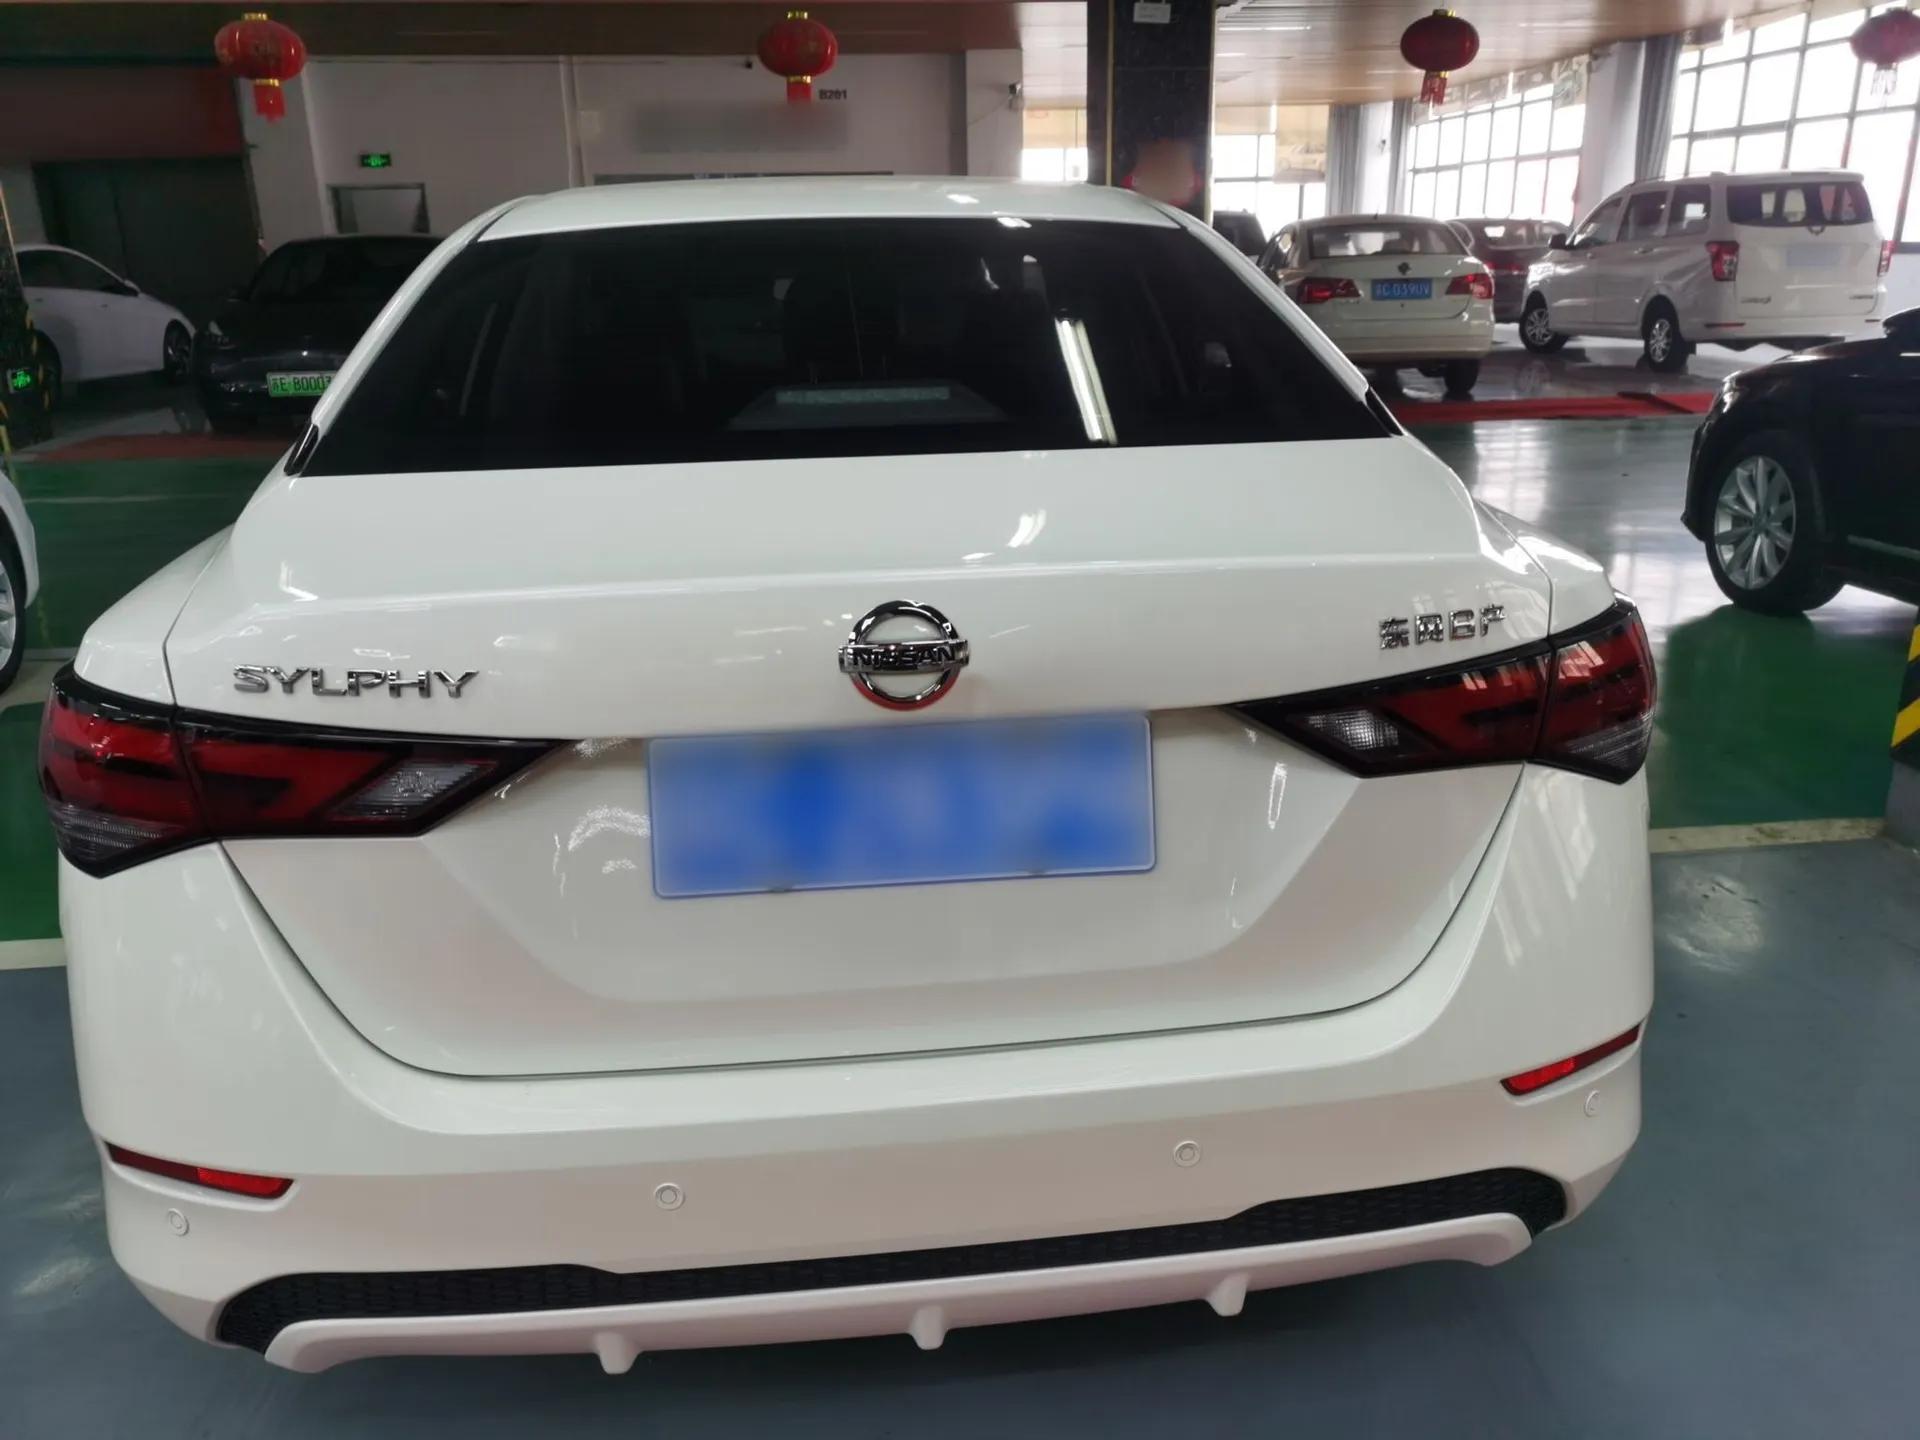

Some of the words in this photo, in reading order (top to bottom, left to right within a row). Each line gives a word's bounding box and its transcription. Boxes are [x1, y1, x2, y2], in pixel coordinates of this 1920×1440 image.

[1379, 603, 1506, 650] 东风日产
[848, 644, 955, 669] NISSAN
[233, 664, 480, 699] SYLPHY
